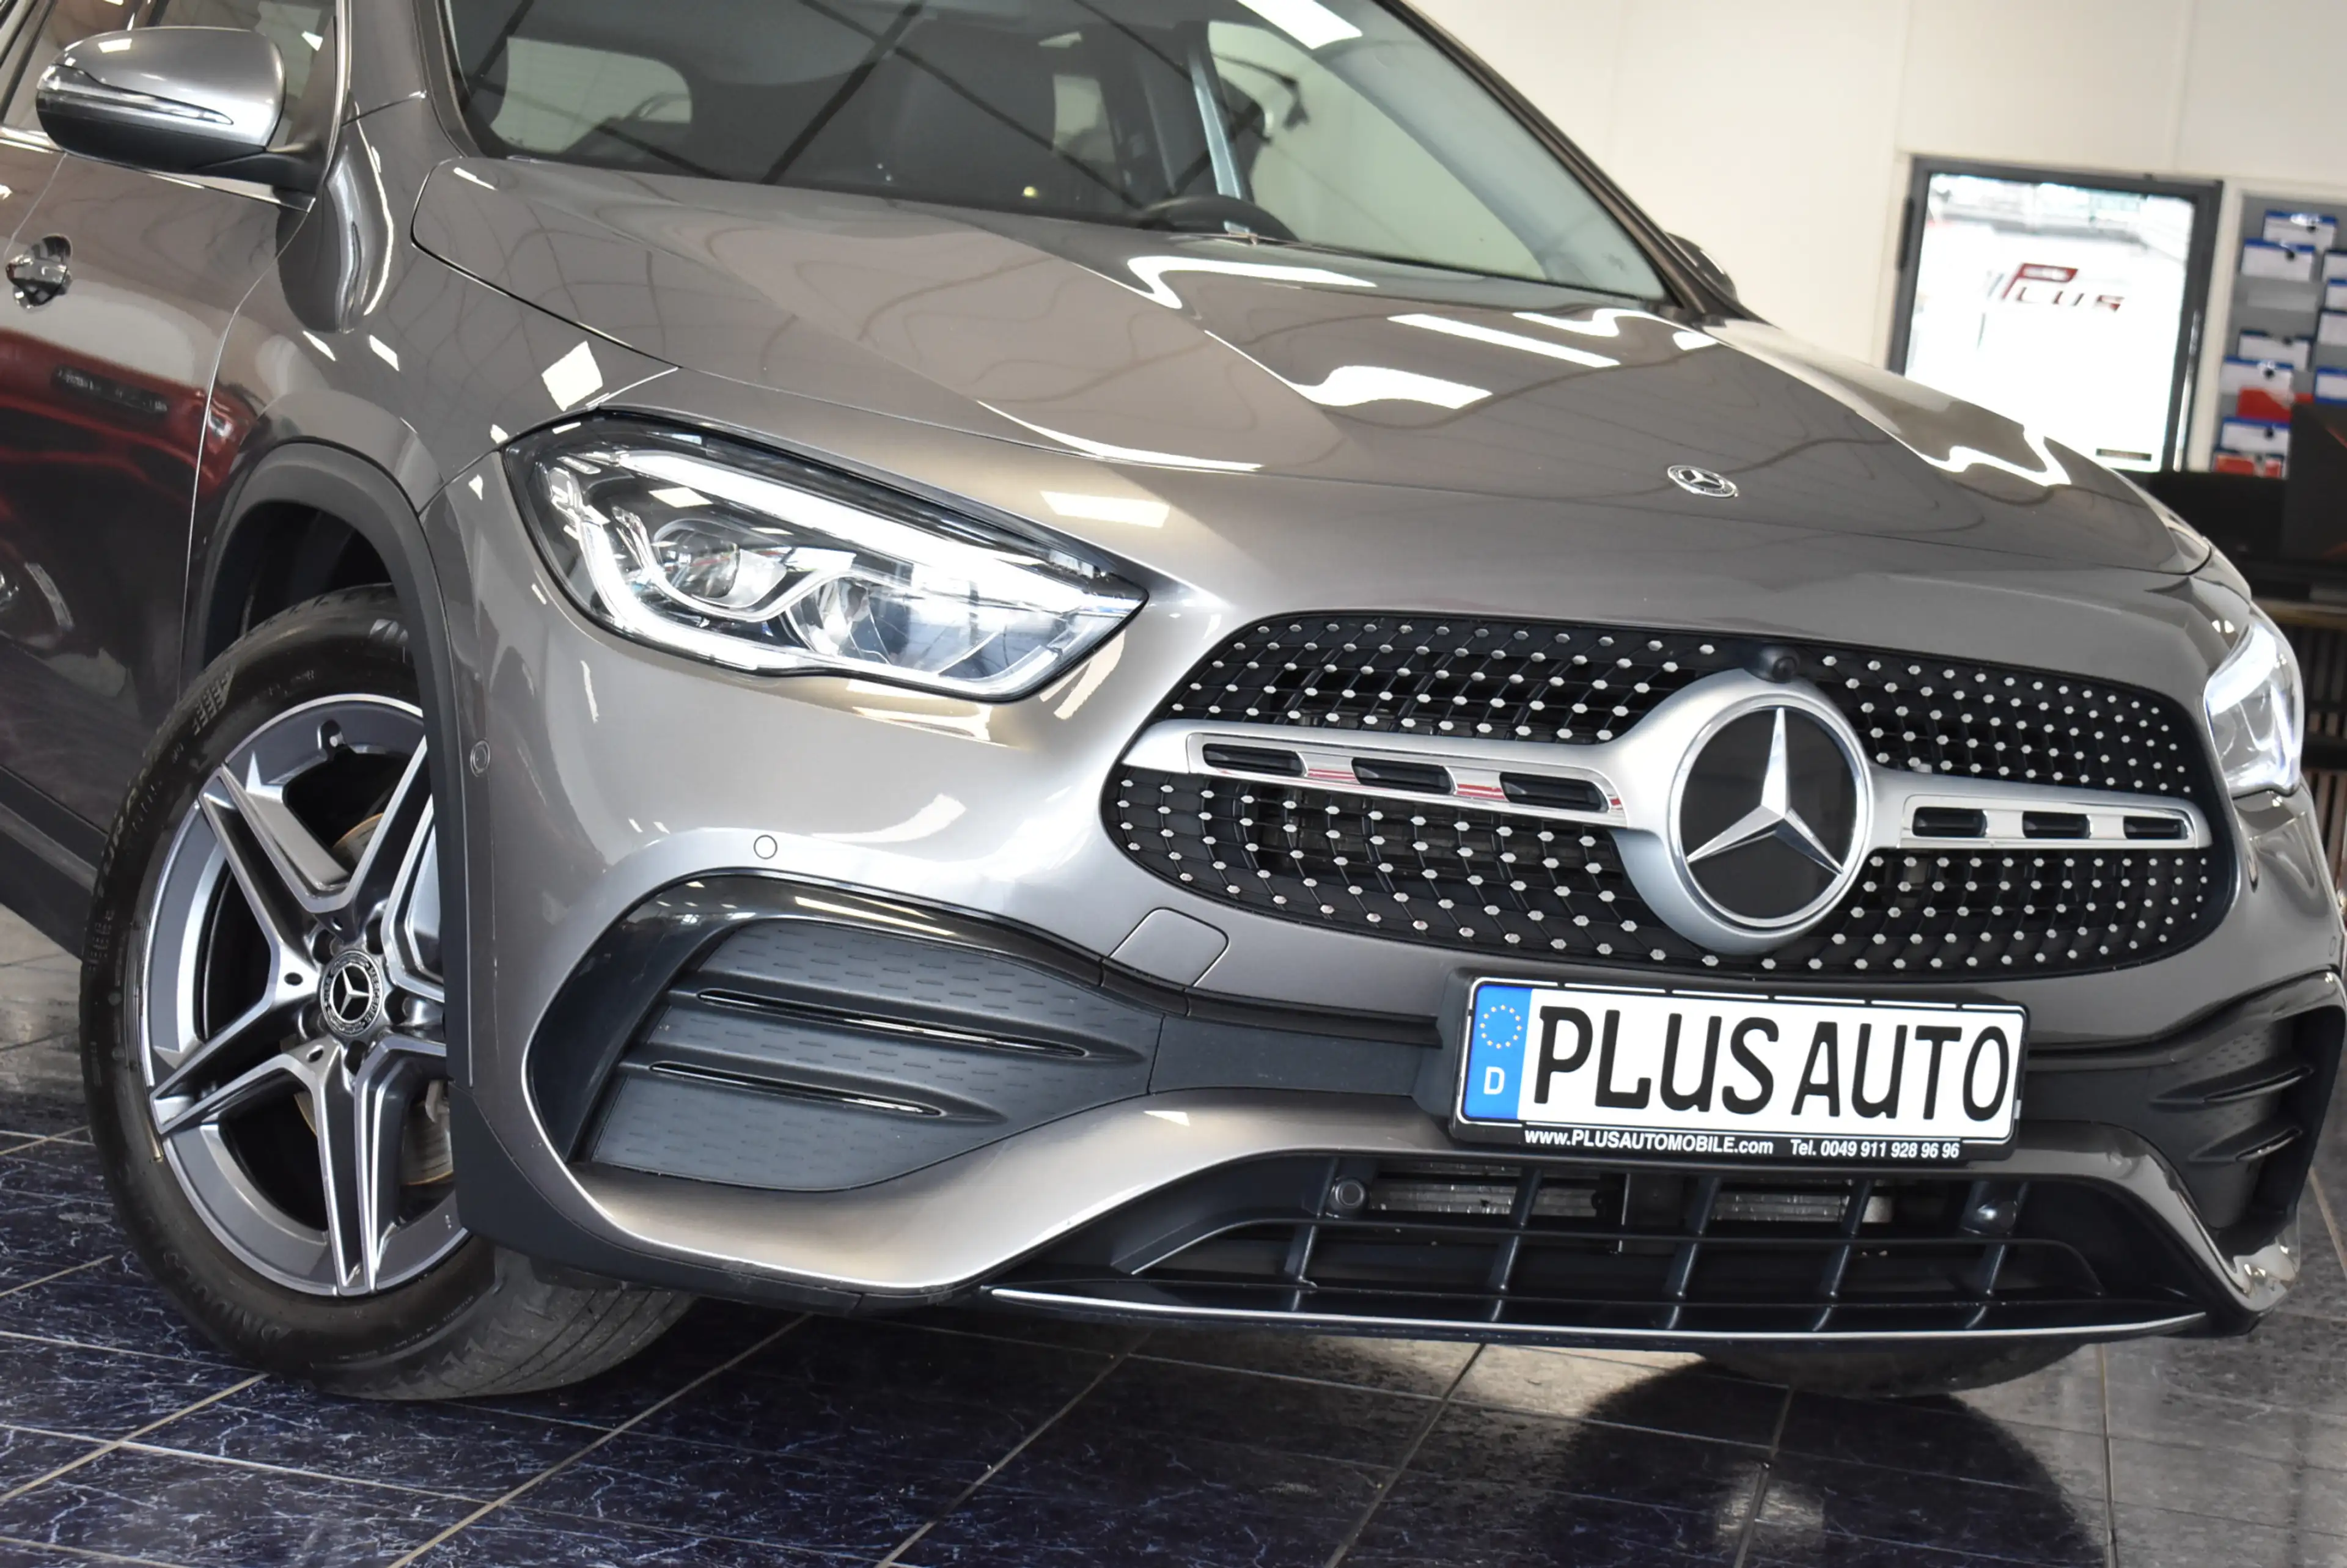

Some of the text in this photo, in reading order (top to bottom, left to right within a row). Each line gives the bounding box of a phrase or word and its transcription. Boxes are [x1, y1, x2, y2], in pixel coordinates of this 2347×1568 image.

[1533, 1005, 2010, 1122] PLUS AUTO
[1483, 1066, 1505, 1095] D
[1524, 1129, 1774, 1154] www.PLUSAUTOMOBILE.com
[1790, 1138, 1960, 1159] Tel. 0049 911 928 96 96
